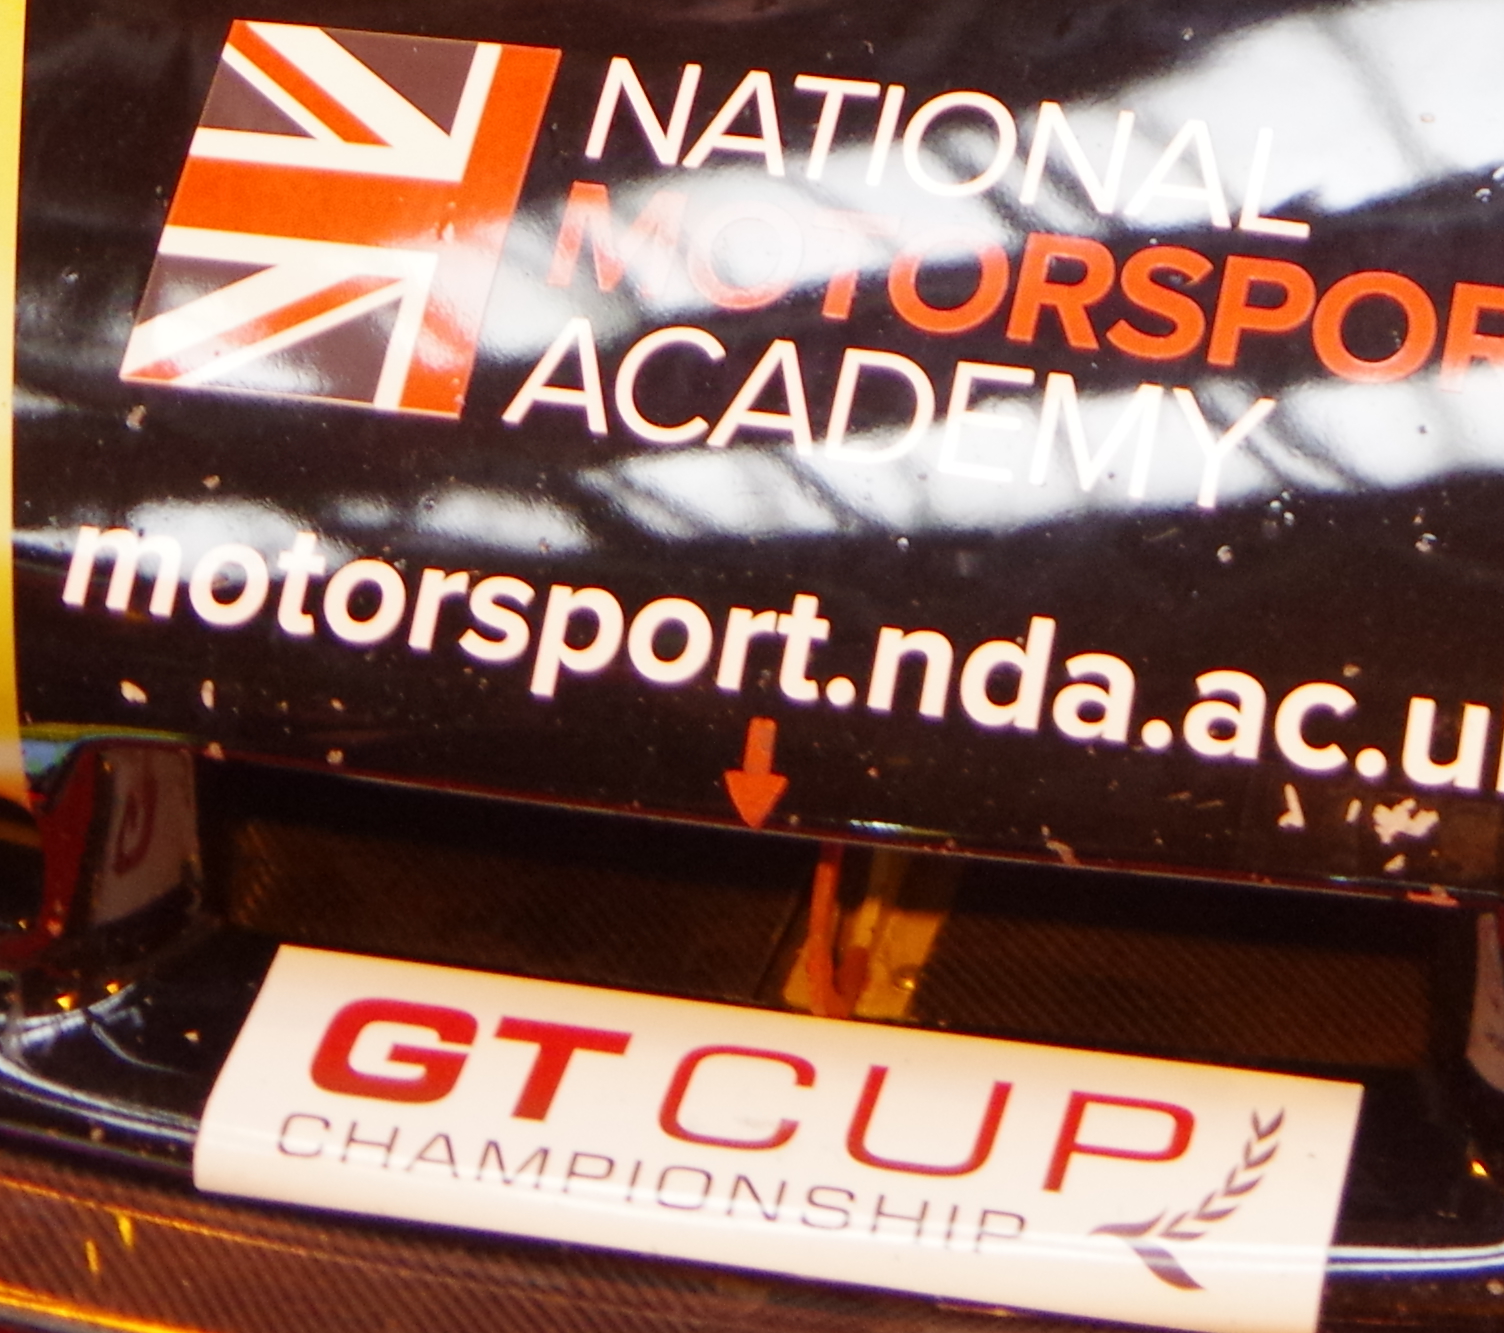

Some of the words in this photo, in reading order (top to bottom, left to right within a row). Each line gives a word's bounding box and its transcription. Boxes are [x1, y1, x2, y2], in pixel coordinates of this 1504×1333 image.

[584, 55, 1311, 240] NATIONAL
[501, 314, 1276, 512] ACADEMY
[275, 1110, 1029, 1257] CHAMPIONSHIP
[308, 996, 633, 1124] GT
[656, 1041, 1198, 1195] CUP
